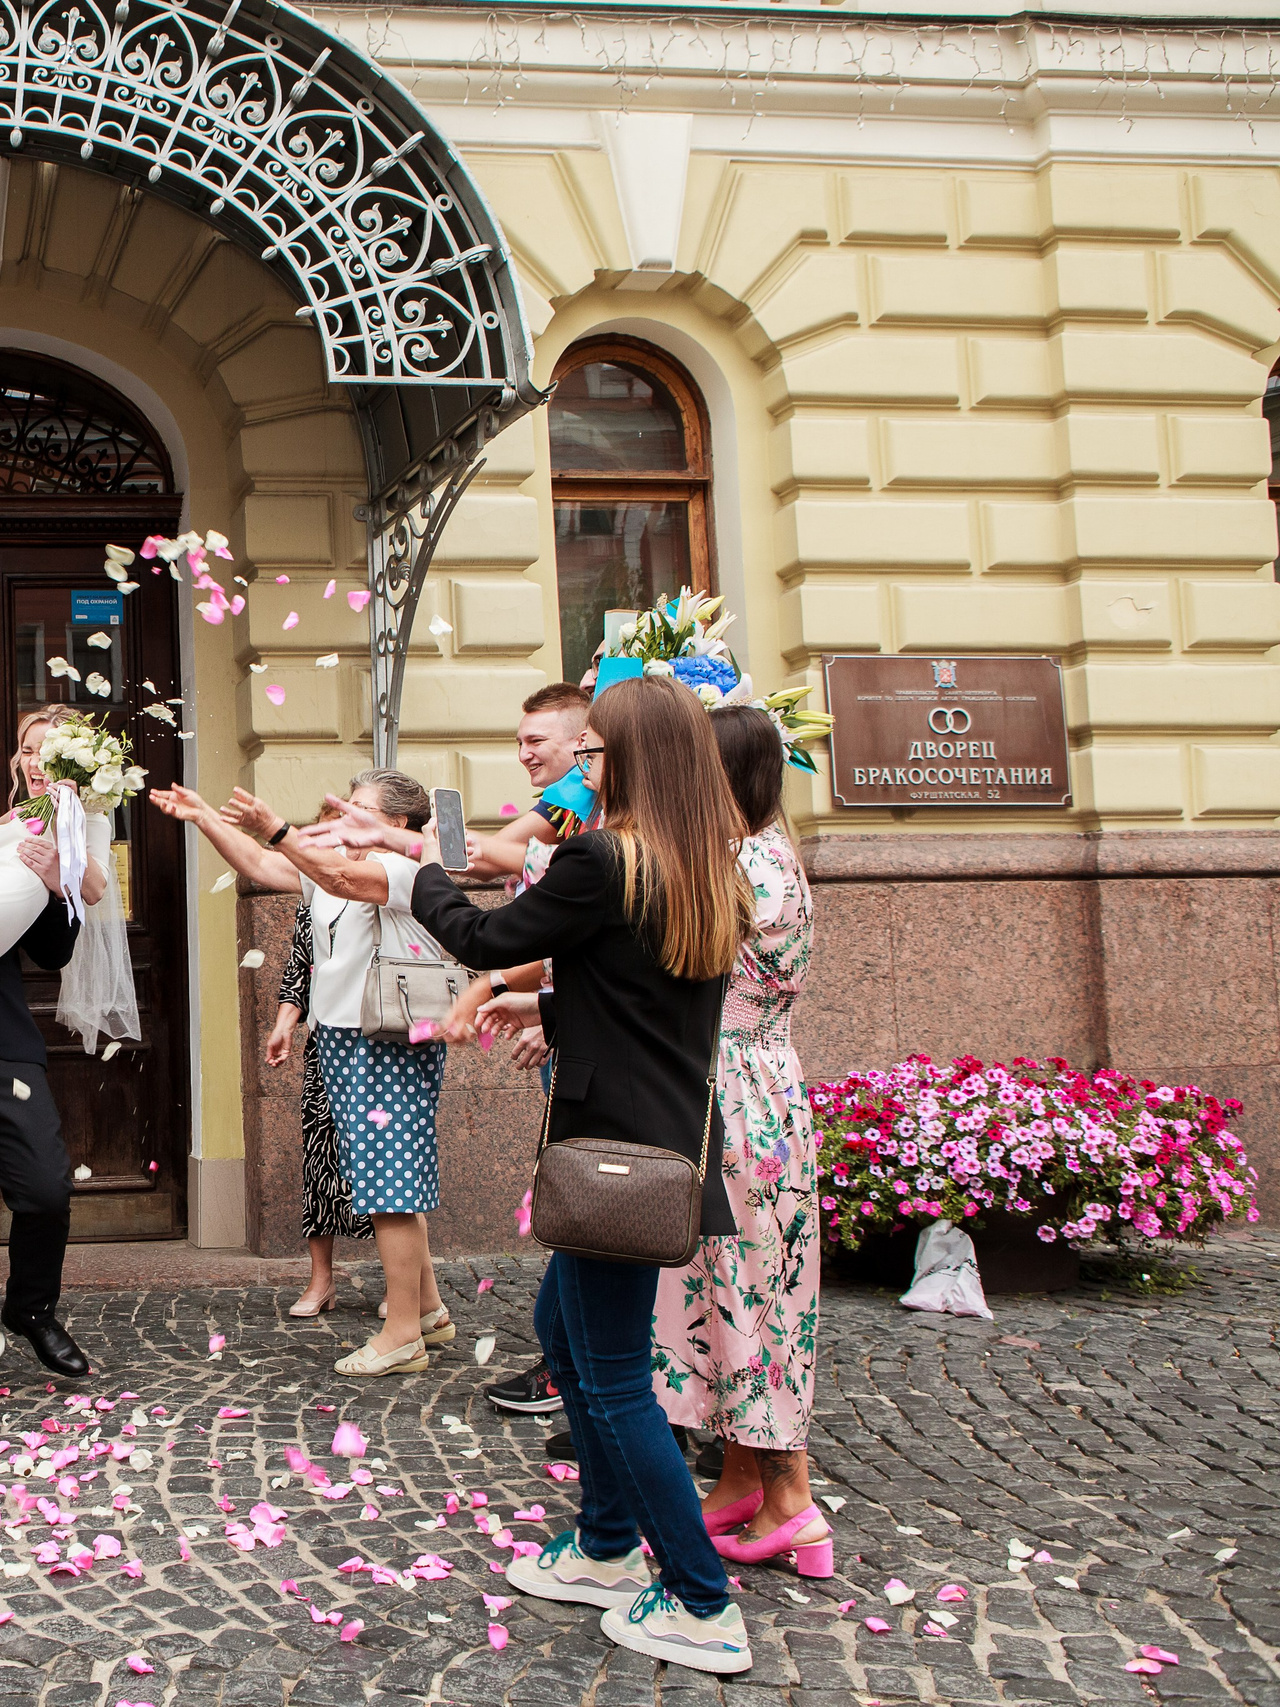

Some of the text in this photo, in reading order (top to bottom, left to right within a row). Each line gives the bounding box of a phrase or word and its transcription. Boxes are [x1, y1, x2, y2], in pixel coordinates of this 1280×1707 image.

[907, 741, 997, 761] ДВОРЕЦ
[853, 767, 1053, 785] БРАКОСОЧЕТАНИЯ
[986, 789, 1001, 799] 52
